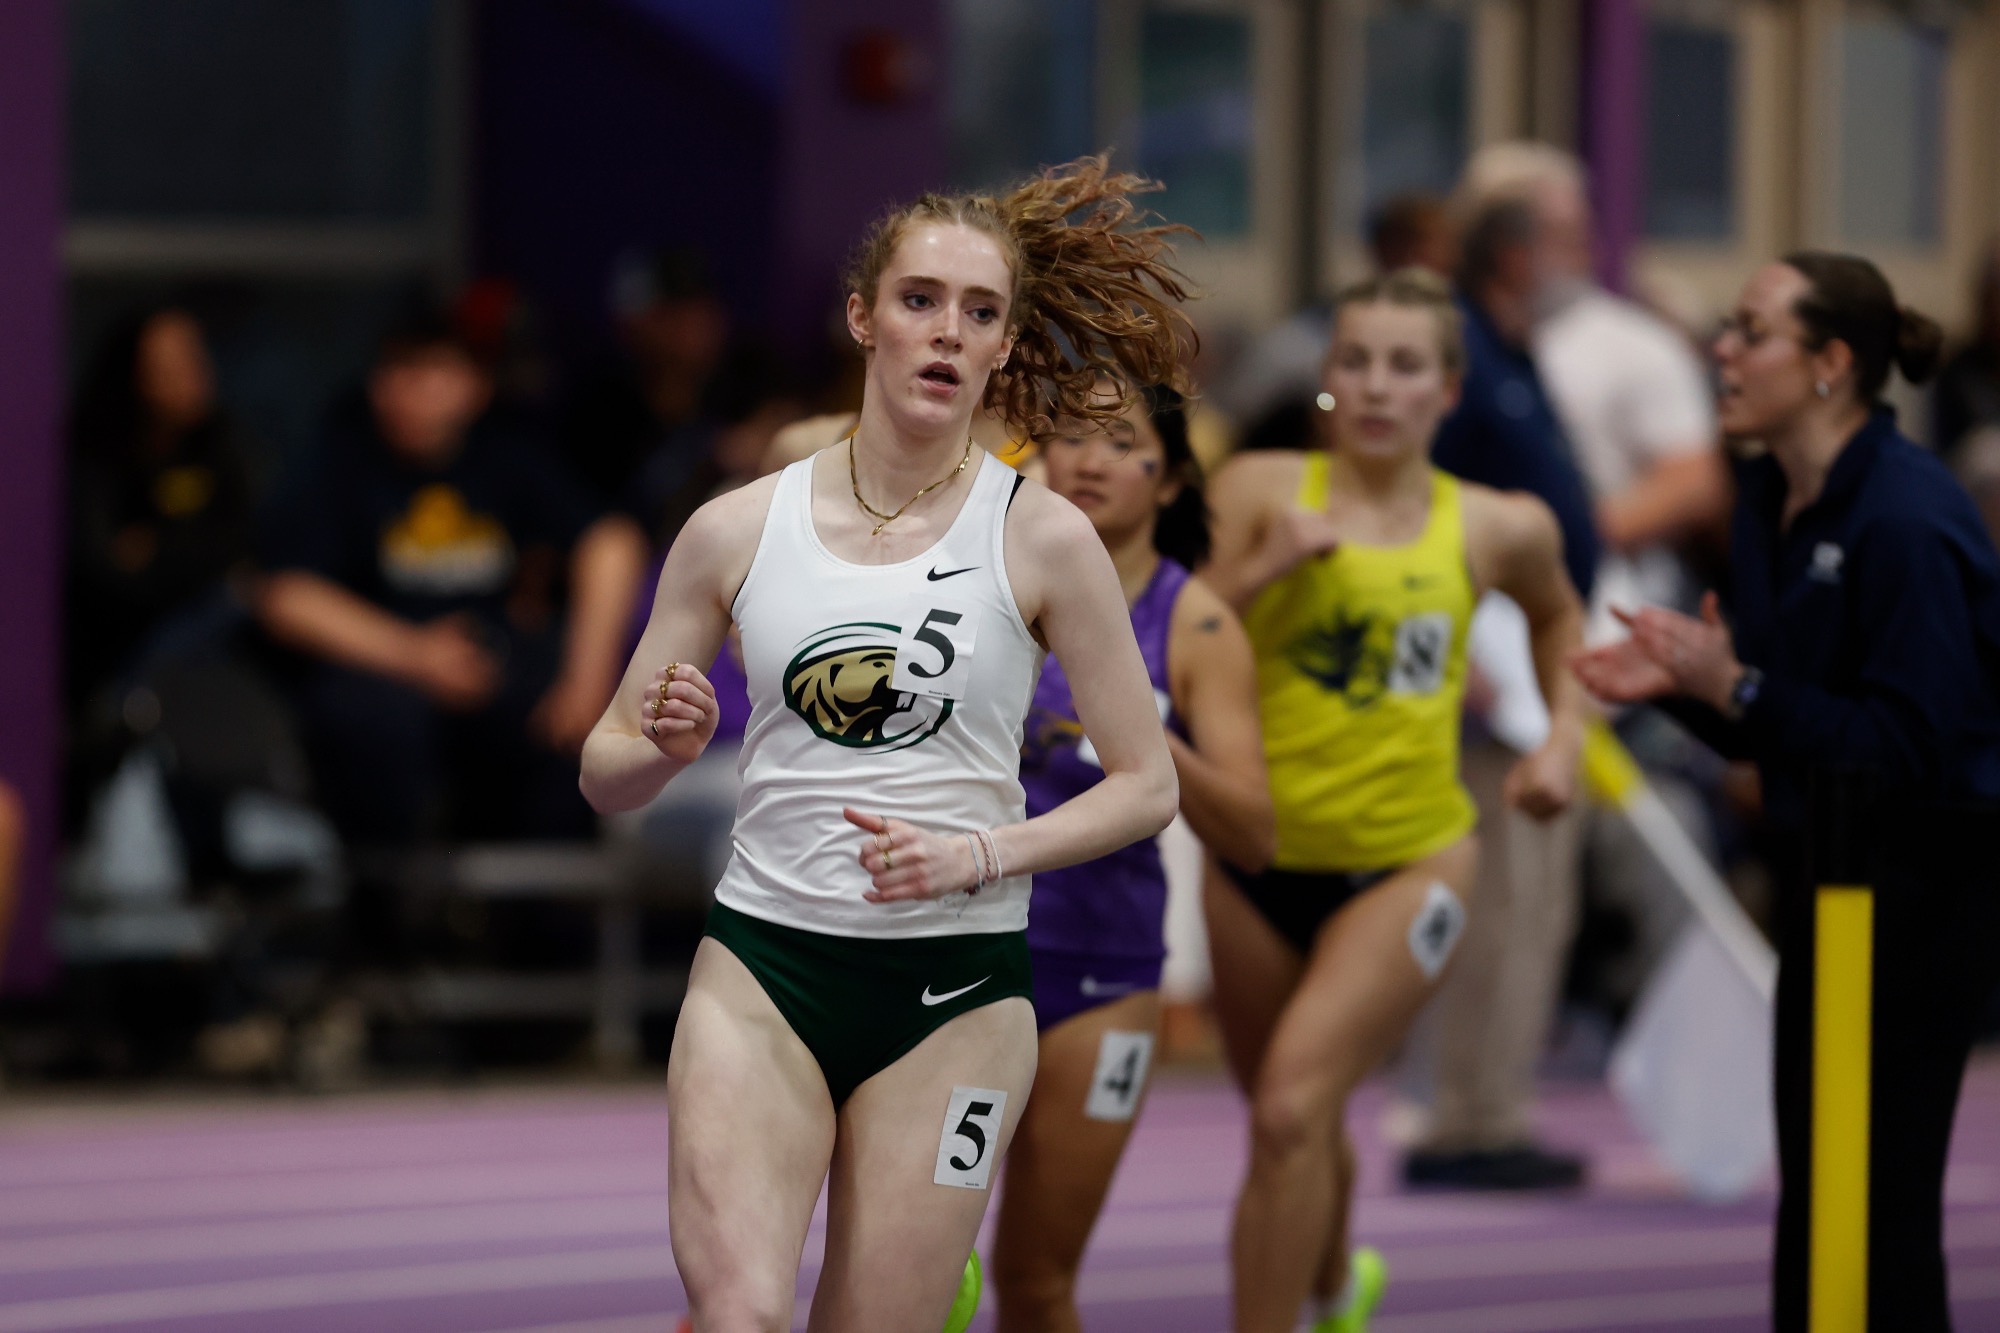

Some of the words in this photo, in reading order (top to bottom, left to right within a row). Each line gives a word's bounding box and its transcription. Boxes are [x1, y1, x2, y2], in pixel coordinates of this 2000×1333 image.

[907, 608, 963, 679] 5
[1103, 1046, 1141, 1105] 4
[949, 1101, 994, 1171] 5
